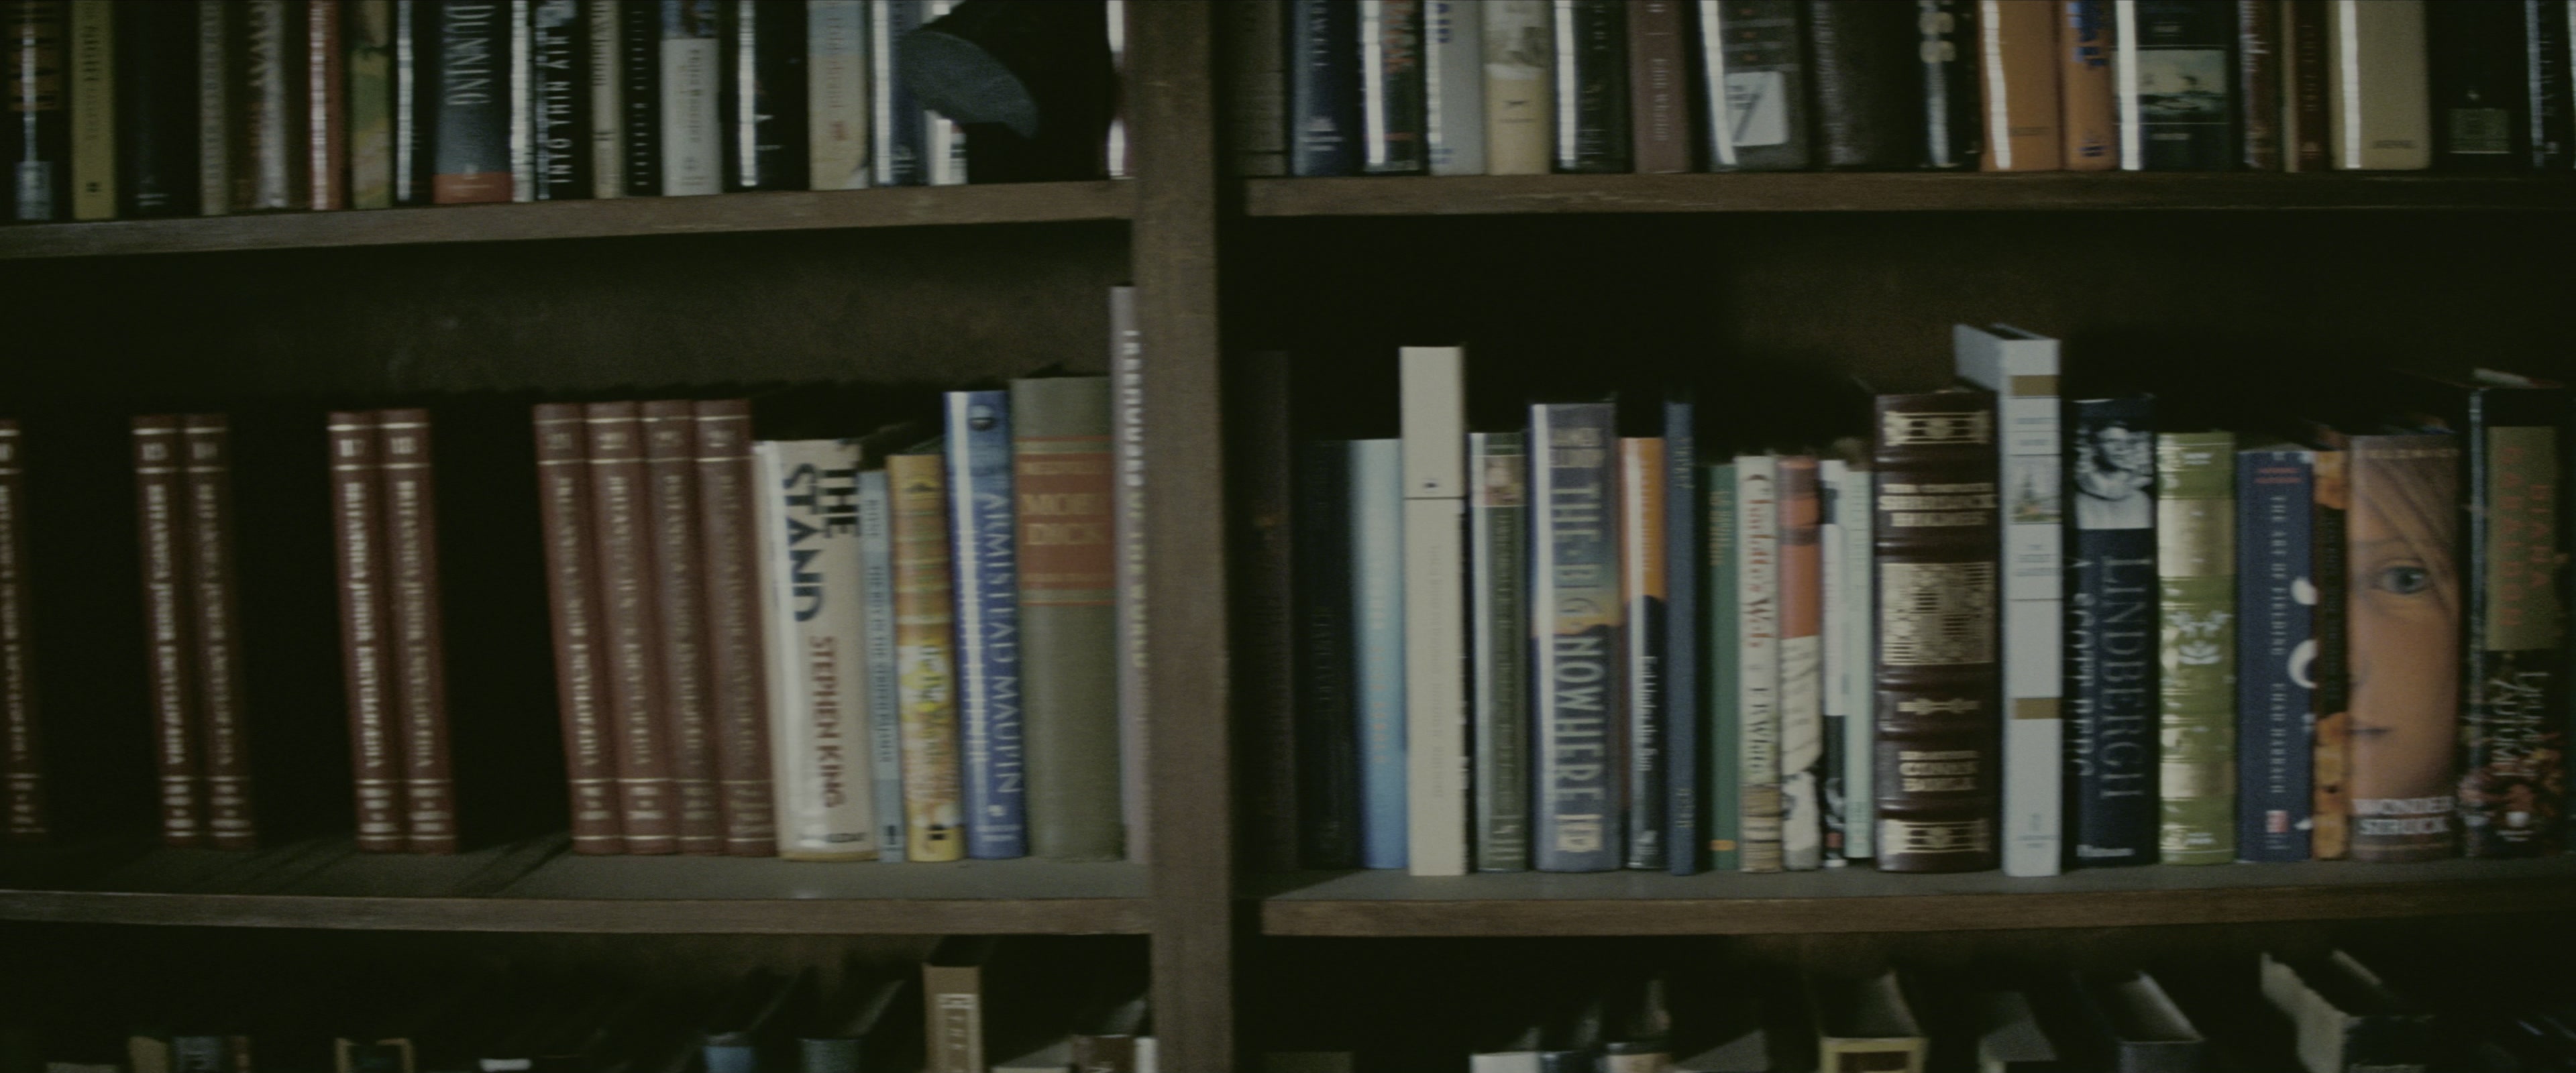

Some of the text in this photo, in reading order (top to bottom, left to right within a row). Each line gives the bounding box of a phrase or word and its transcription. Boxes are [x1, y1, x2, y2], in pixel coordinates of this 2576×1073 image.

[443, 4, 496, 106] DUNNING
[545, 35, 574, 184] INTO THIN AIR
[782, 462, 826, 624] STAND
[820, 469, 861, 539] THE
[809, 635, 843, 739] STEPHEN
[1553, 636, 1604, 803] NOWHERE
[2098, 556, 2153, 802] LINDBERGH
[817, 744, 848, 809] KING
